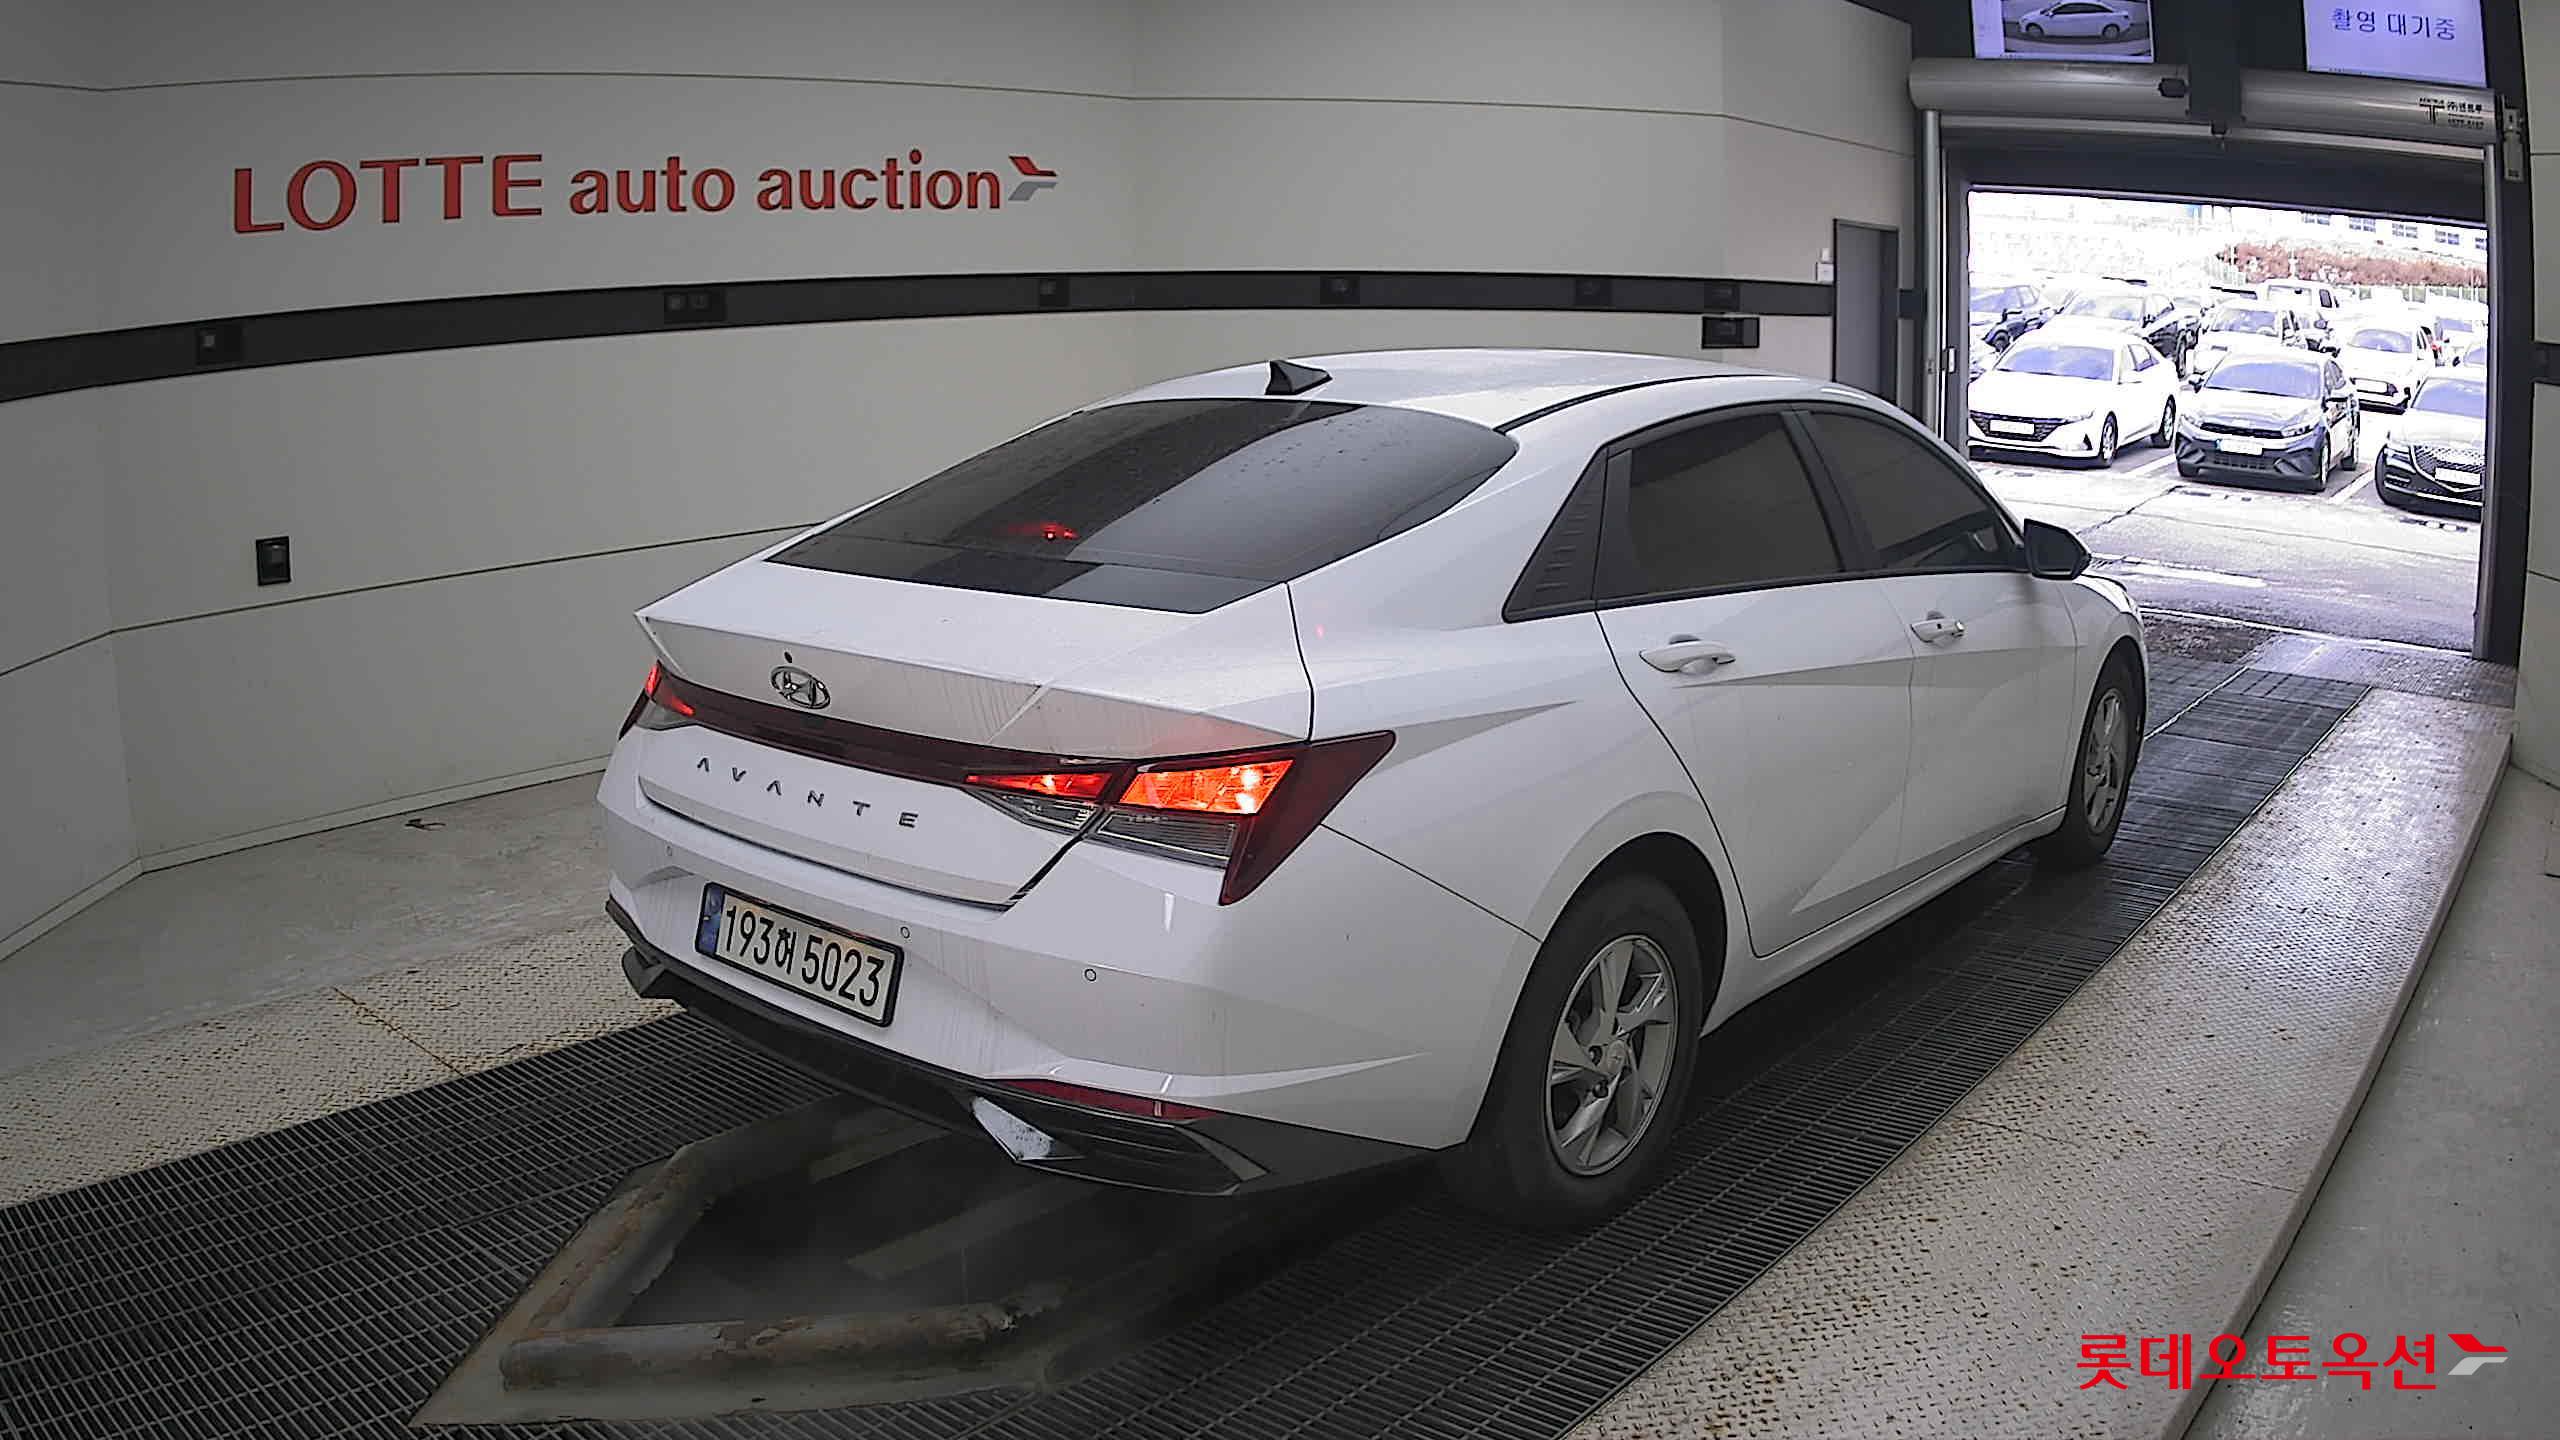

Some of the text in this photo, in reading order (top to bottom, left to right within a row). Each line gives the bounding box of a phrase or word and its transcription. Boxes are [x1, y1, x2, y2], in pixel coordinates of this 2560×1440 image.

[2332, 8, 2456, 41] 촬영 대기중
[235, 149, 1001, 233] LOTTE auto auction
[697, 757, 919, 828] AVANTE
[725, 905, 885, 1007] 193허 5023
